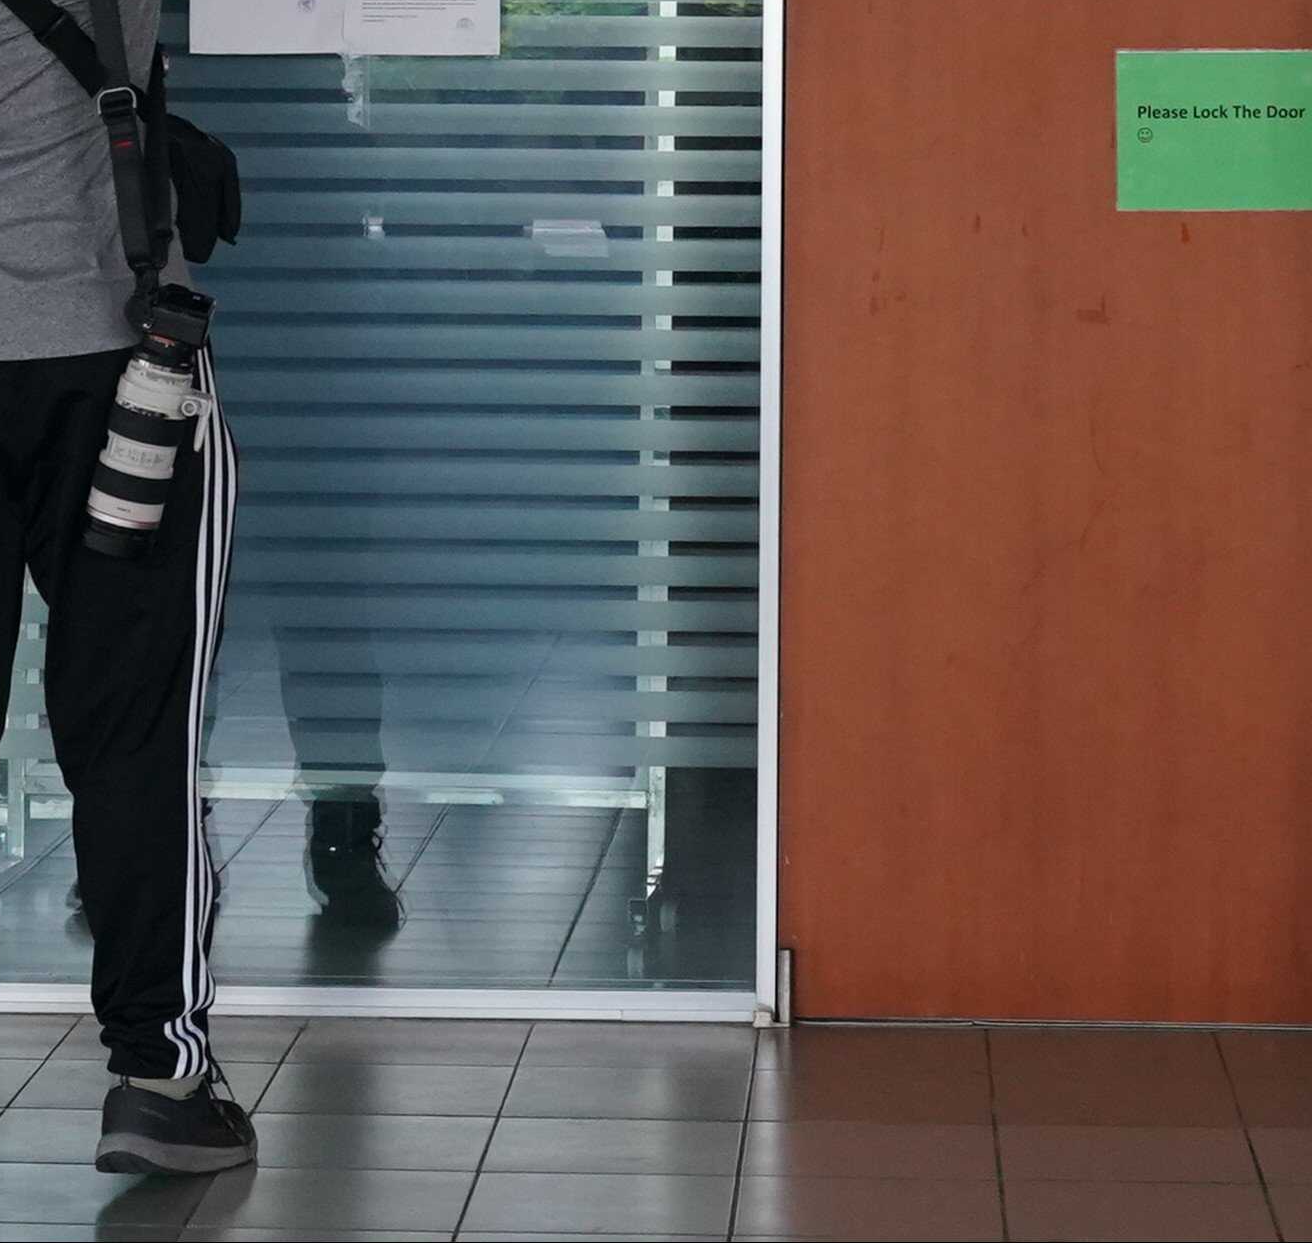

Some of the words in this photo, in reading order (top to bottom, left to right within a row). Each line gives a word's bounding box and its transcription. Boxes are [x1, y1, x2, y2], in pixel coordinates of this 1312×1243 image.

[1138, 106, 1188, 119] Please
[1193, 106, 1228, 119] Lock
[1233, 106, 1262, 119] The
[1267, 106, 1306, 119] Door
